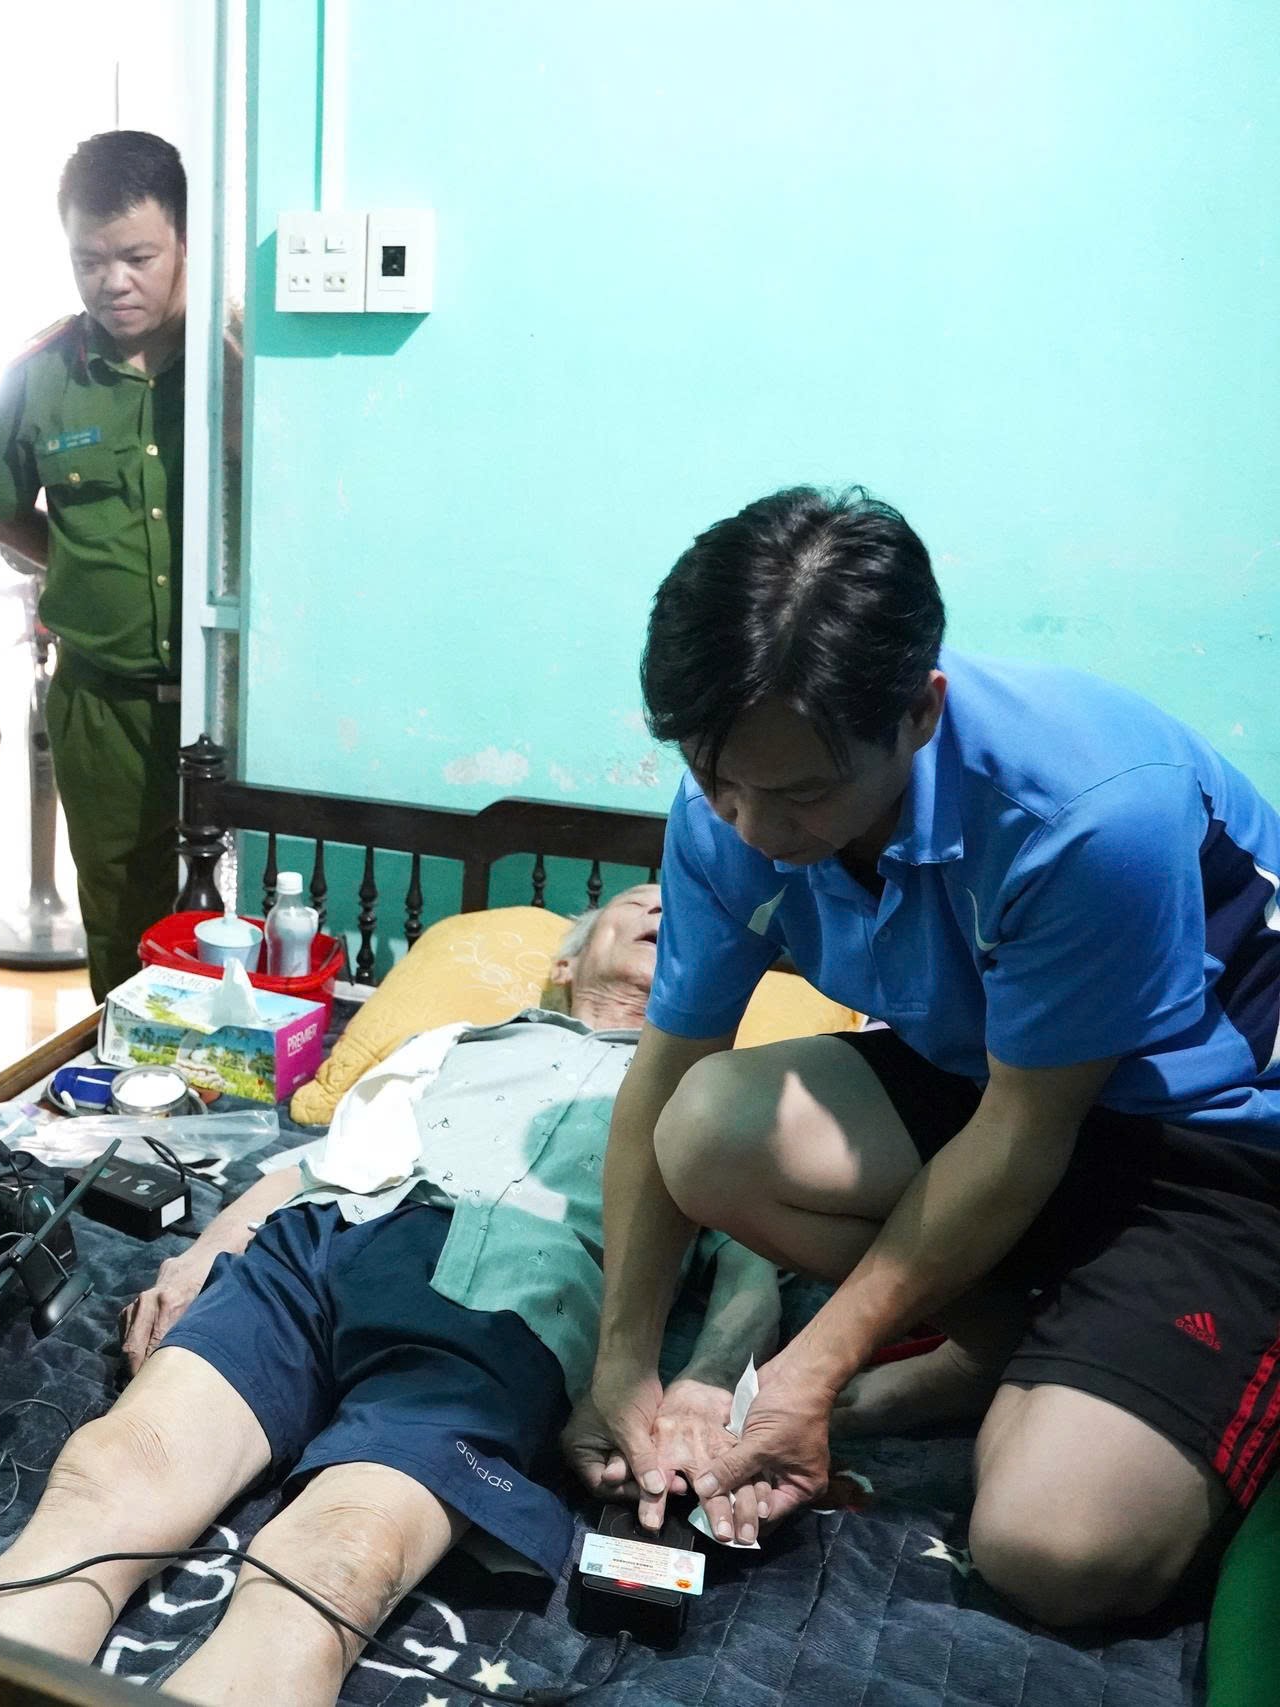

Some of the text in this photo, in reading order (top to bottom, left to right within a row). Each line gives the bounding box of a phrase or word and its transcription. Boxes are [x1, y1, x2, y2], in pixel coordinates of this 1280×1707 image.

[287, 1023, 318, 1053] PREMIER
[1174, 1318, 1222, 1351] adidas
[455, 1440, 513, 1492] adidas
